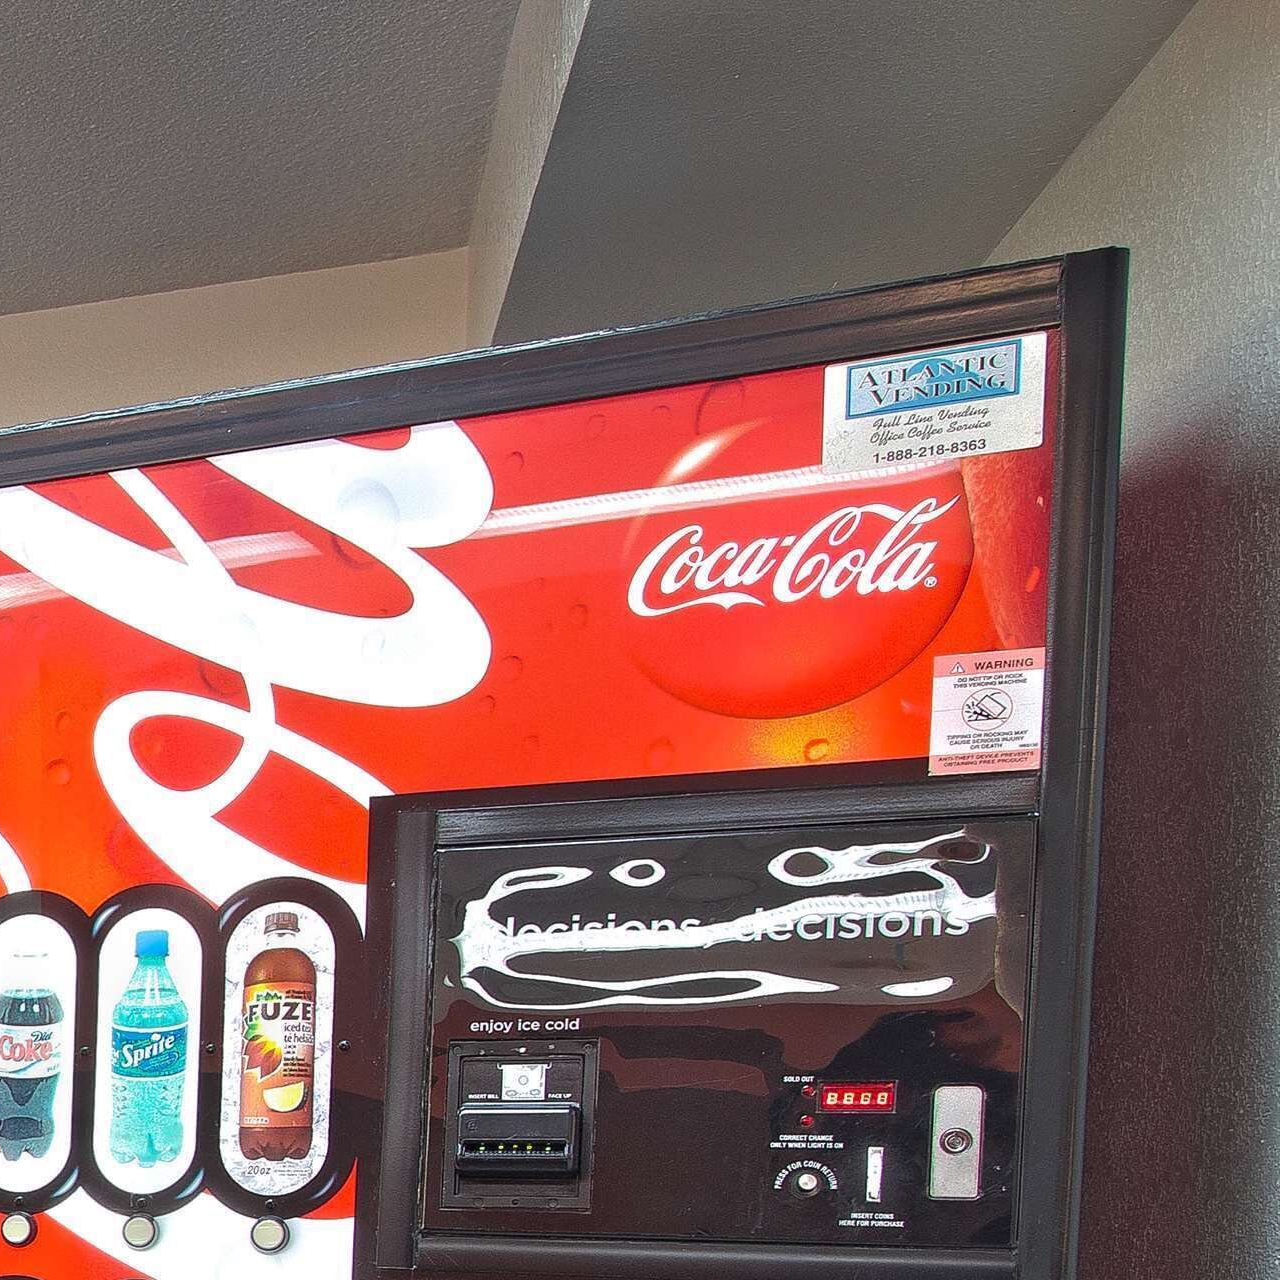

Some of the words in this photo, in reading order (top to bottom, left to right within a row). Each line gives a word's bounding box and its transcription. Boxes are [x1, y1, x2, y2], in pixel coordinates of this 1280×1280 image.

[859, 352, 1008, 390] ATLANTIC
[869, 373, 1006, 405] VENDING
[873, 417, 901, 431] Full
[903, 414, 933, 427] Line
[937, 405, 990, 421] Vending
[870, 429, 904, 445] Office
[907, 424, 942, 442] Coffee
[946, 419, 991, 433] Service
[872, 439, 986, 464] 1-888-218-8363
[627, 494, 961, 617] Coca-Cola
[974, 657, 1034, 671] WARNING
[249, 1001, 311, 1022] FUZE
[470, 1019, 513, 1033] enjoy
[518, 1019, 540, 1031] ice
[545, 1018, 580, 1030] cold
[122, 1033, 175, 1067] Sprite
